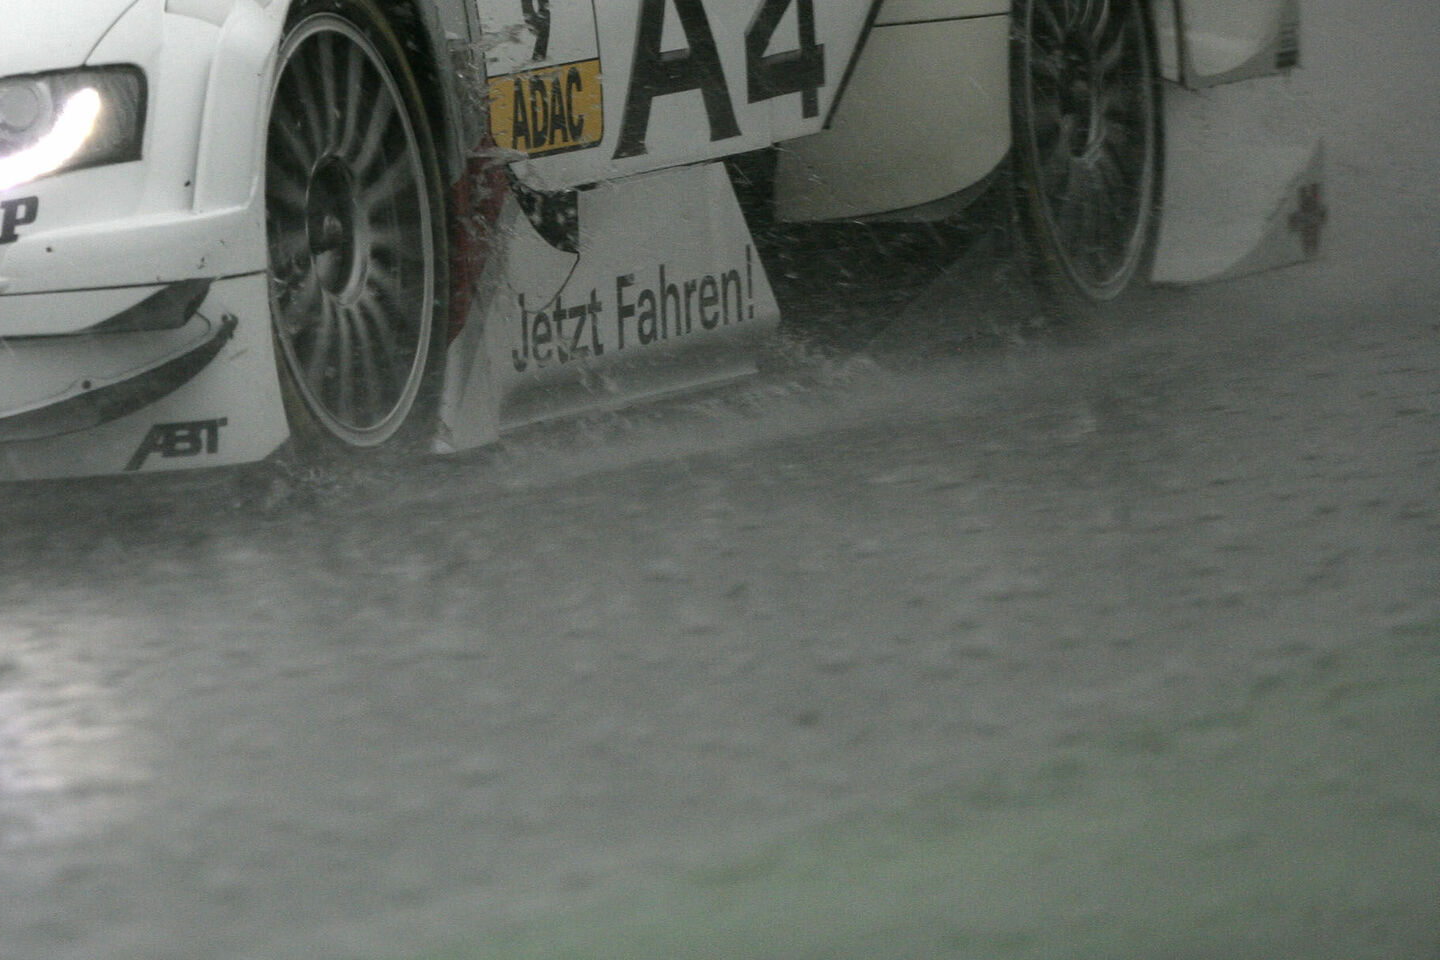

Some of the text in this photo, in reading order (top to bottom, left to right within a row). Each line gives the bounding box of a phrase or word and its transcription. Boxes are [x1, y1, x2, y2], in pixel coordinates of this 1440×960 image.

[511, 66, 584, 149] ADAC
[511, 243, 754, 373] Jetzt Fahren!
[123, 417, 228, 471] ABT
